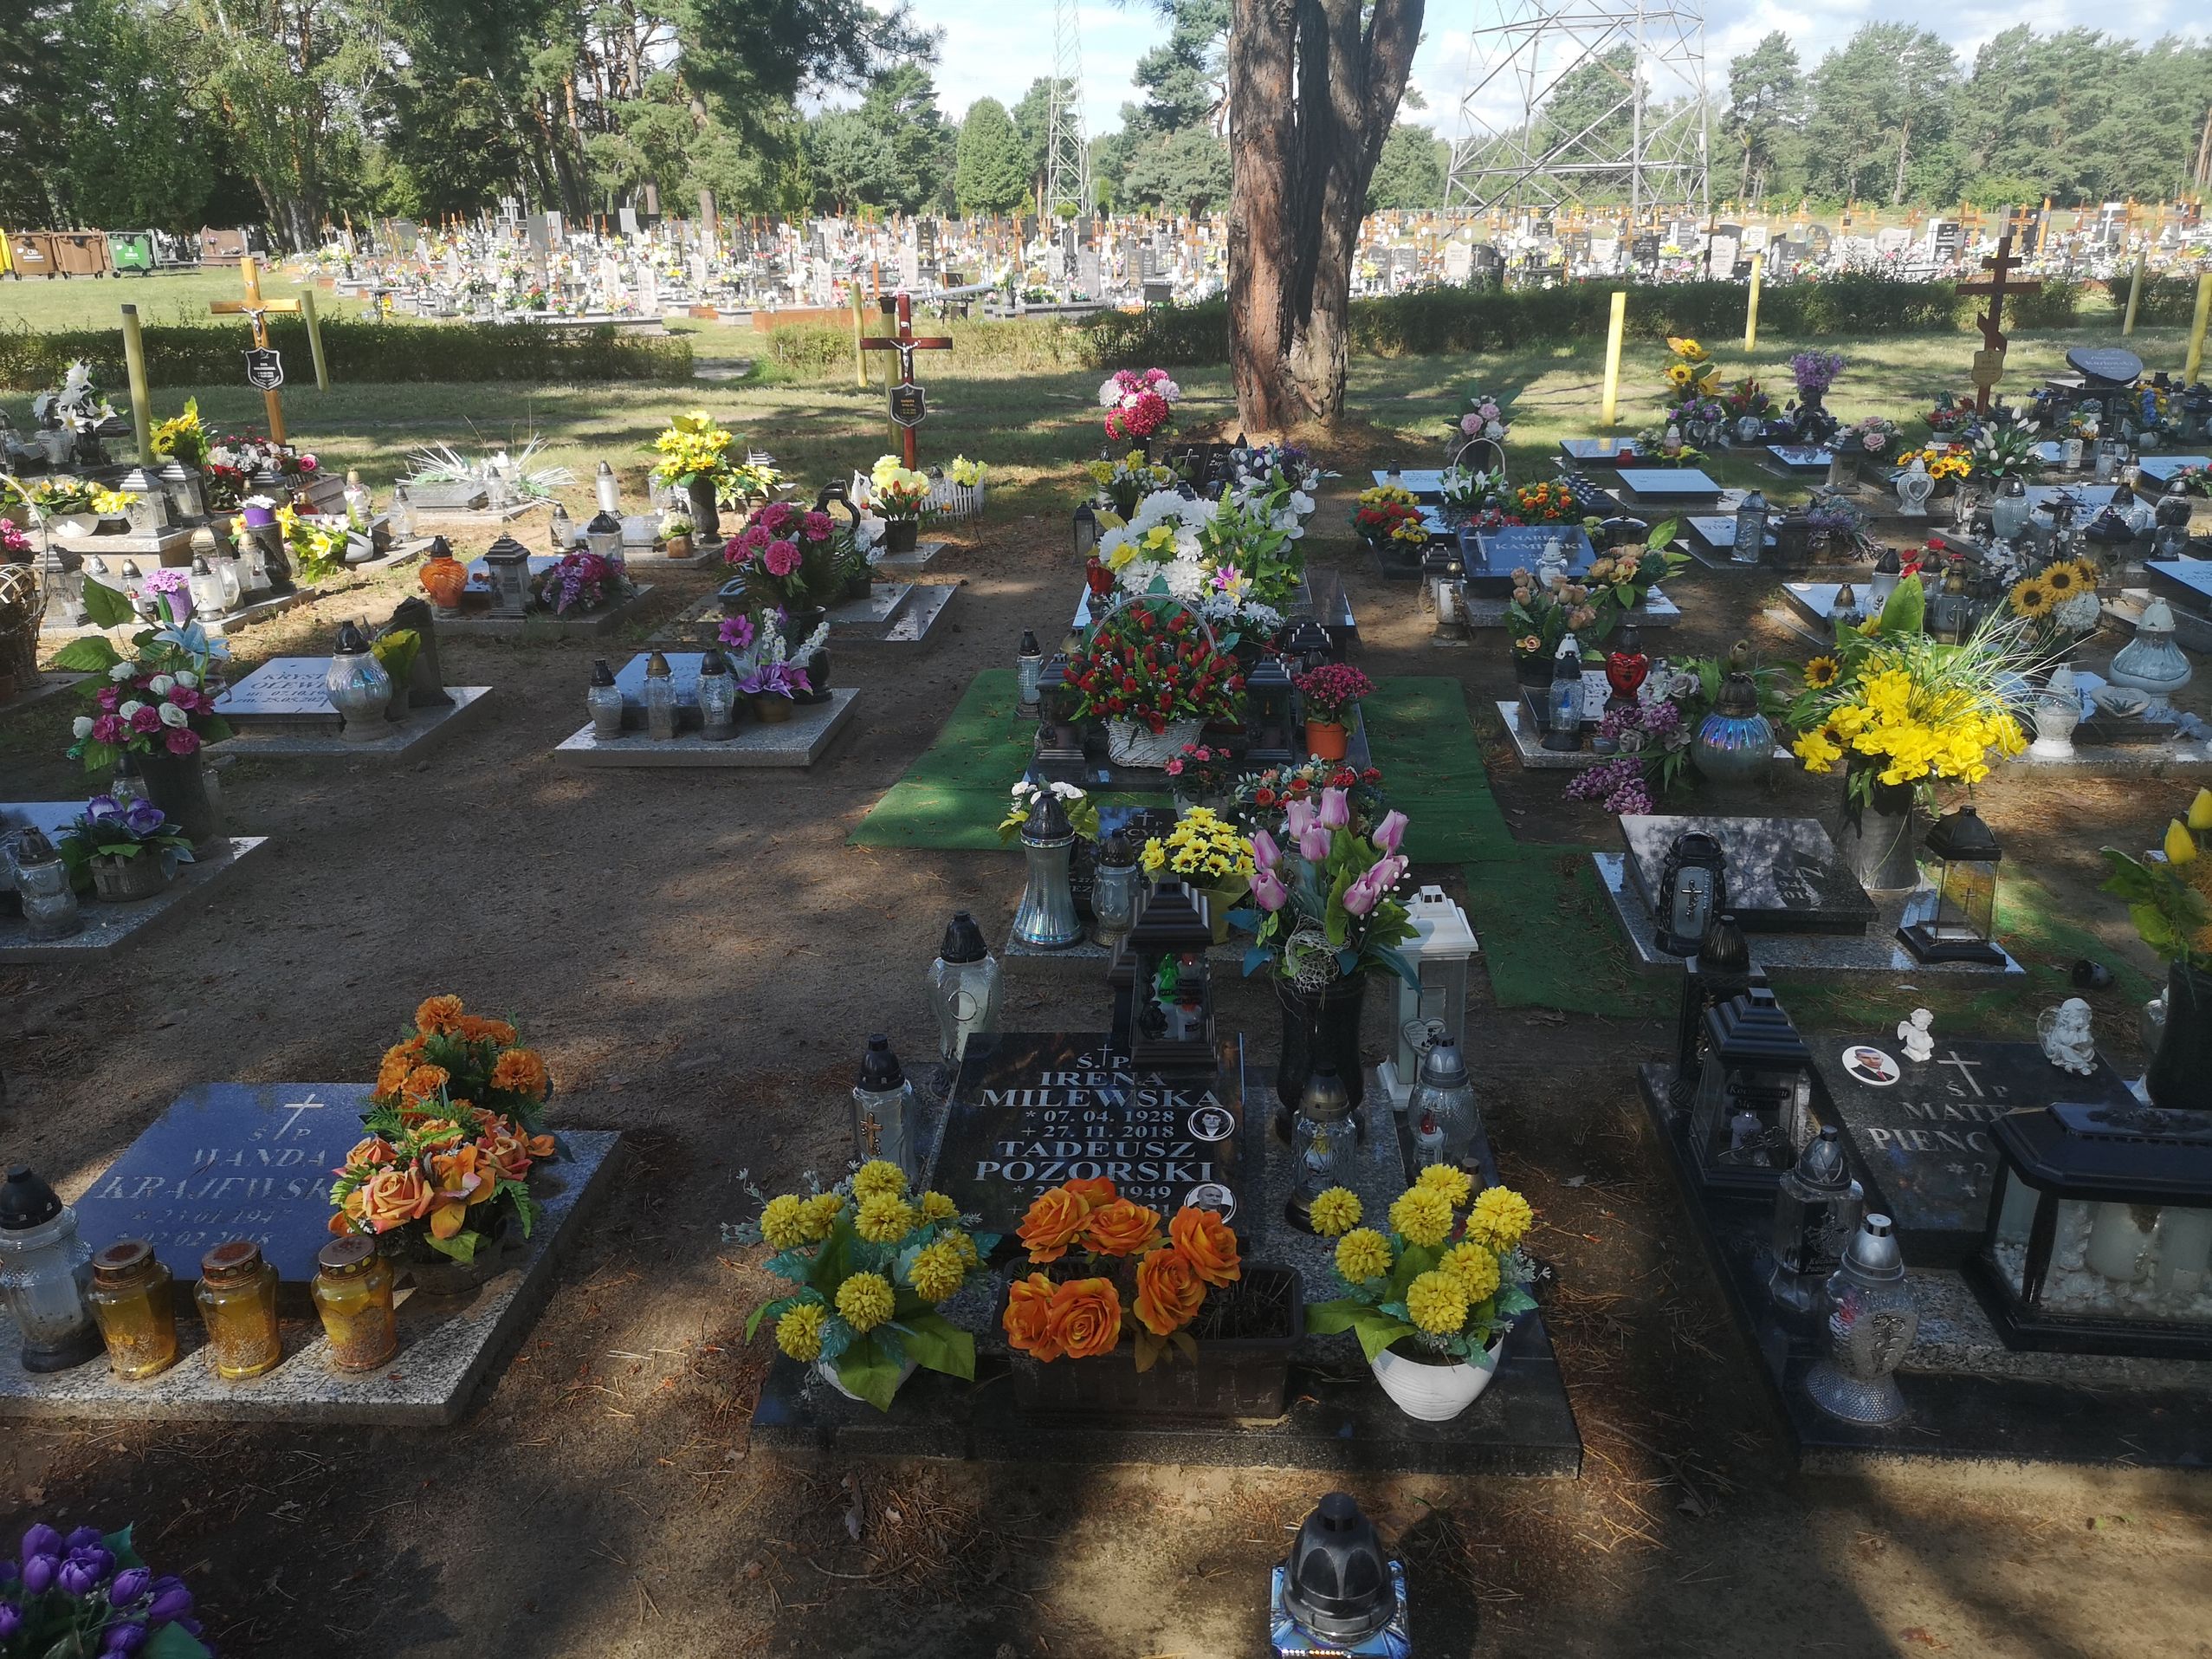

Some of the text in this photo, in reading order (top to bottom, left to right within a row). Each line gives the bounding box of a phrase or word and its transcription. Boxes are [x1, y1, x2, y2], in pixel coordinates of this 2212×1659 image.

[1038, 1071, 1166, 1088] IRENA
[978, 1088, 1224, 1108] MILEWSKA
[1043, 1110, 1175, 1124] 07. 04. 1928
[1042, 1125, 1174, 1138] 27. 11. 2018
[192, 1148, 327, 1168] WANDA
[998, 1141, 1196, 1158] TADEUSZ
[973, 1161, 1215, 1183] POZORSKI
[1118, 1185, 1172, 1199] 1949
